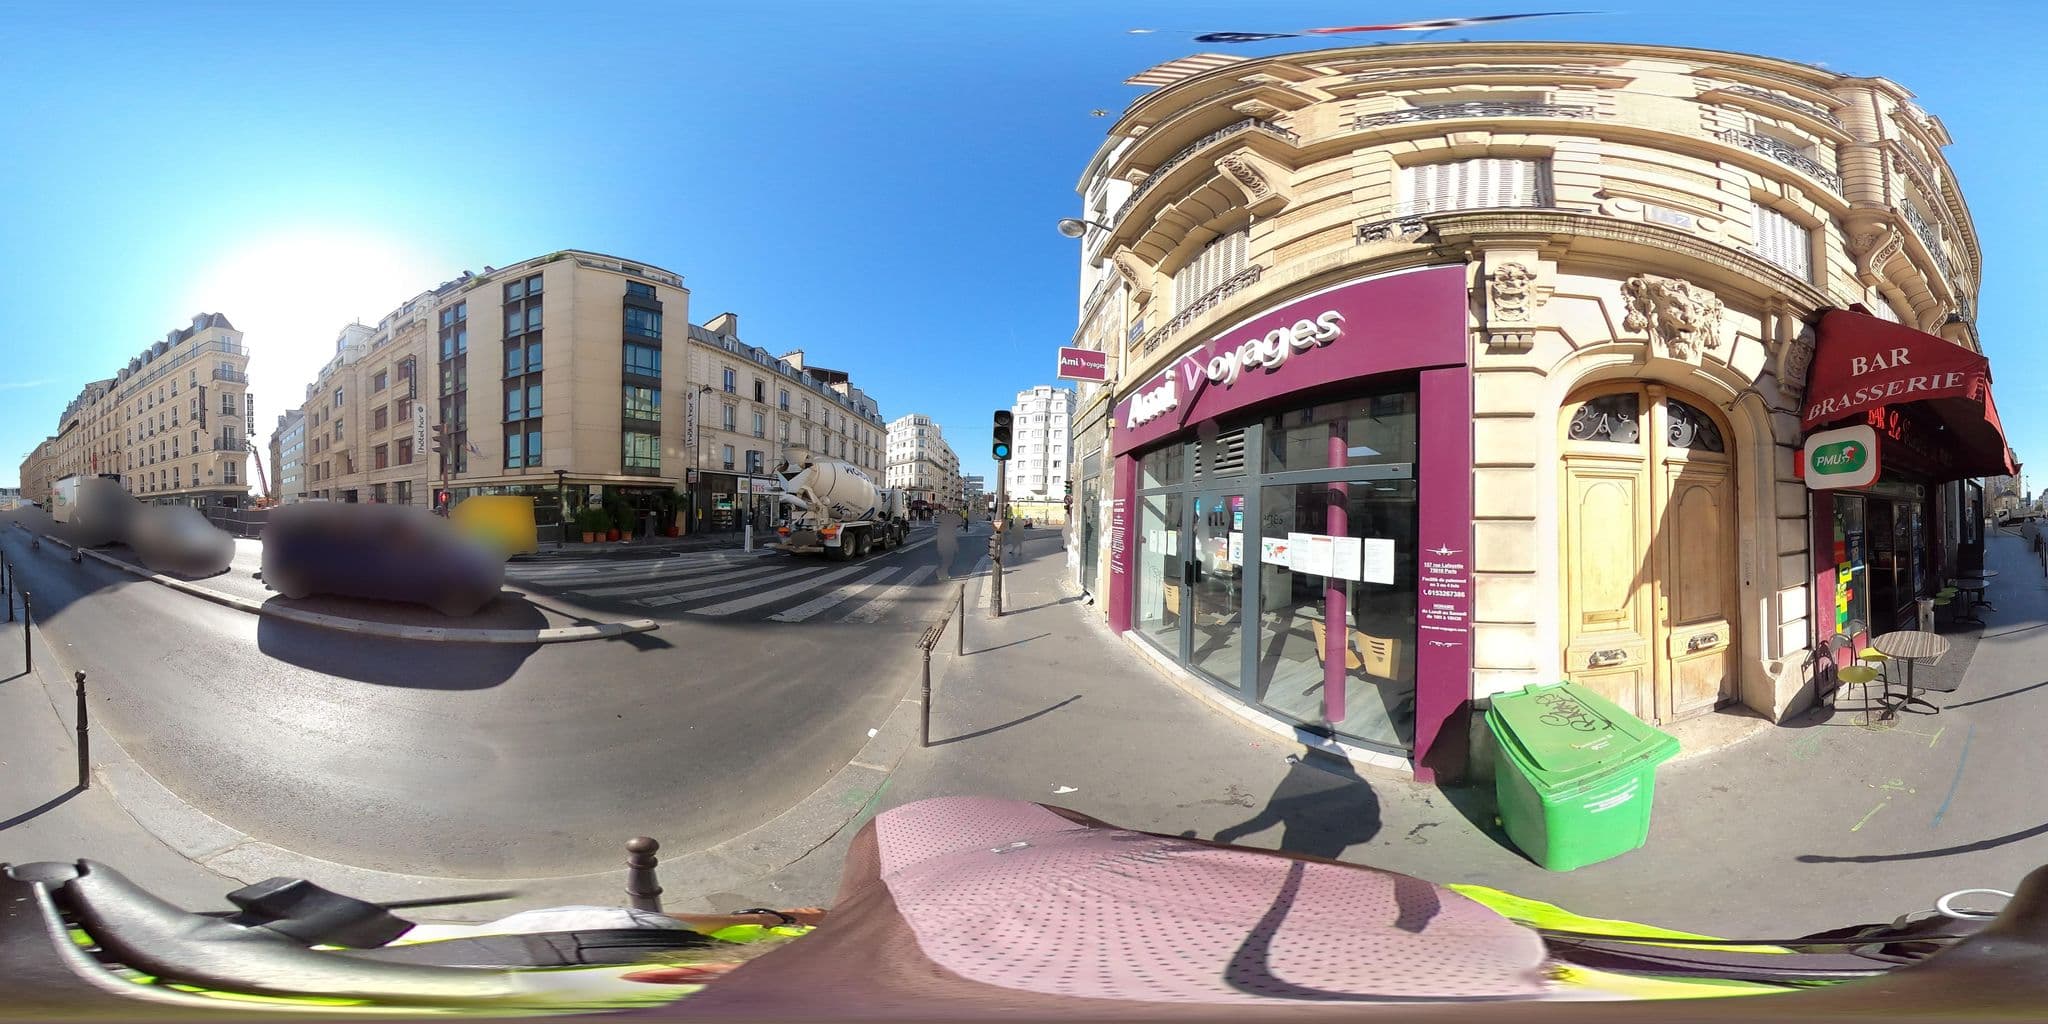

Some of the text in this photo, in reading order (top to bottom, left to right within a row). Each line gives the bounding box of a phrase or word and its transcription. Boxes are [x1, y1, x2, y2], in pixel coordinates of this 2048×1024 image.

[1061, 356, 1079, 367] Ami
[1126, 310, 1346, 430] Ami Voyages
[1851, 347, 1912, 377] BAR
[1807, 372, 1965, 421] BRASSERIE
[1868, 406, 1885, 429] BAR
[1816, 455, 1841, 467] PMU
